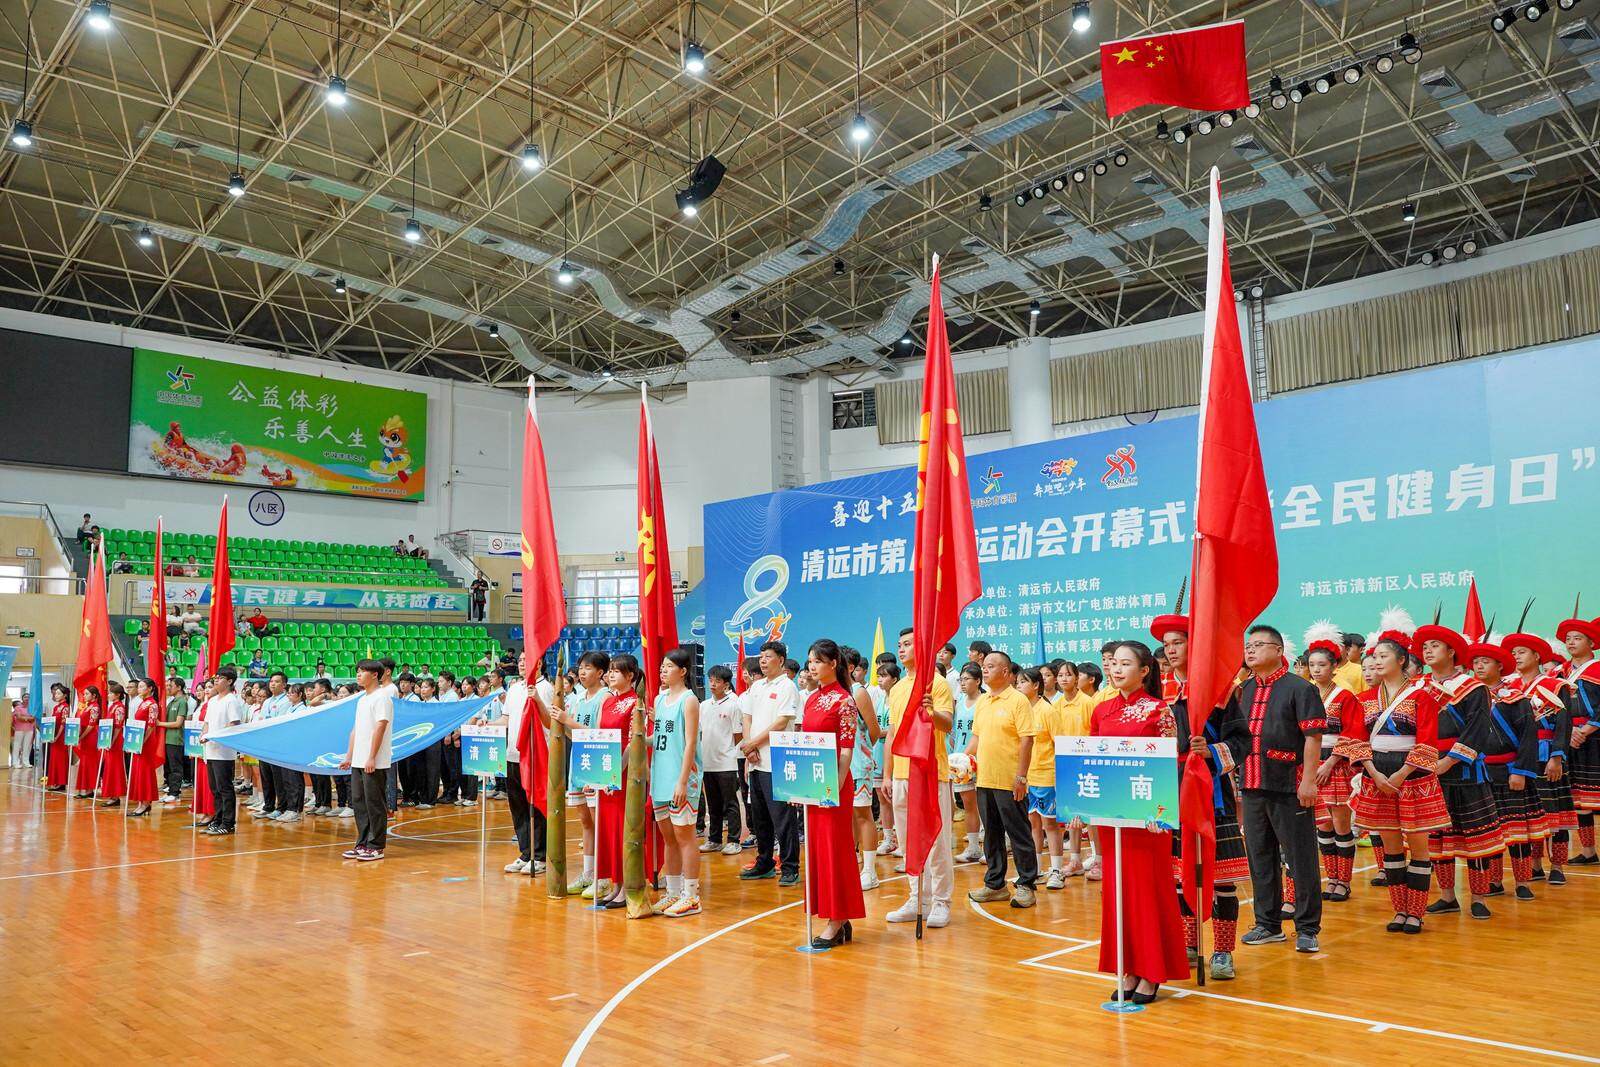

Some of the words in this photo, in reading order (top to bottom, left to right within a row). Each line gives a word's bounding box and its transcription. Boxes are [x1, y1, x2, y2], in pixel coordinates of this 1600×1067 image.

[227, 379, 339, 418] 公益体彩
[264, 416, 367, 449] 乐善人生
[255, 502, 279, 515] 八区
[1300, 570, 1475, 597] 清远市清新区人民政府
[358, 591, 457, 609] 从我做起
[655, 734, 668, 751] 13
[961, 732, 967, 745] 7
[469, 746, 500, 762] 清新
[580, 753, 613, 773] 英德
[784, 760, 825, 784] 佛冈
[1077, 773, 1154, 801] 连南
